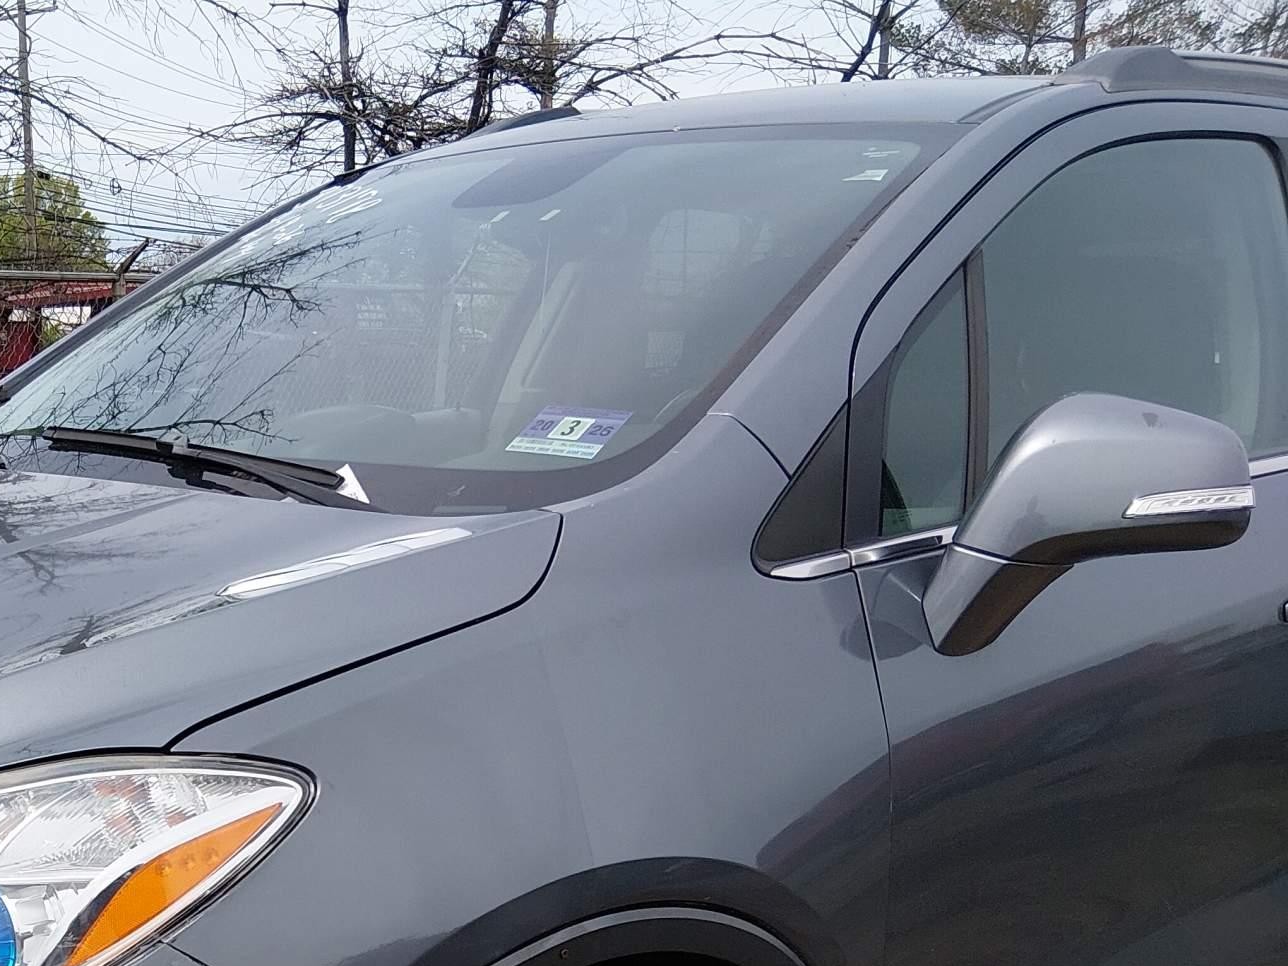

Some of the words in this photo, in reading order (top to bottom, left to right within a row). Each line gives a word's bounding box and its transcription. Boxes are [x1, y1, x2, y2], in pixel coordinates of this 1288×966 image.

[530, 419, 555, 431] 20
[560, 420, 581, 436] 3
[588, 425, 615, 437] 26
